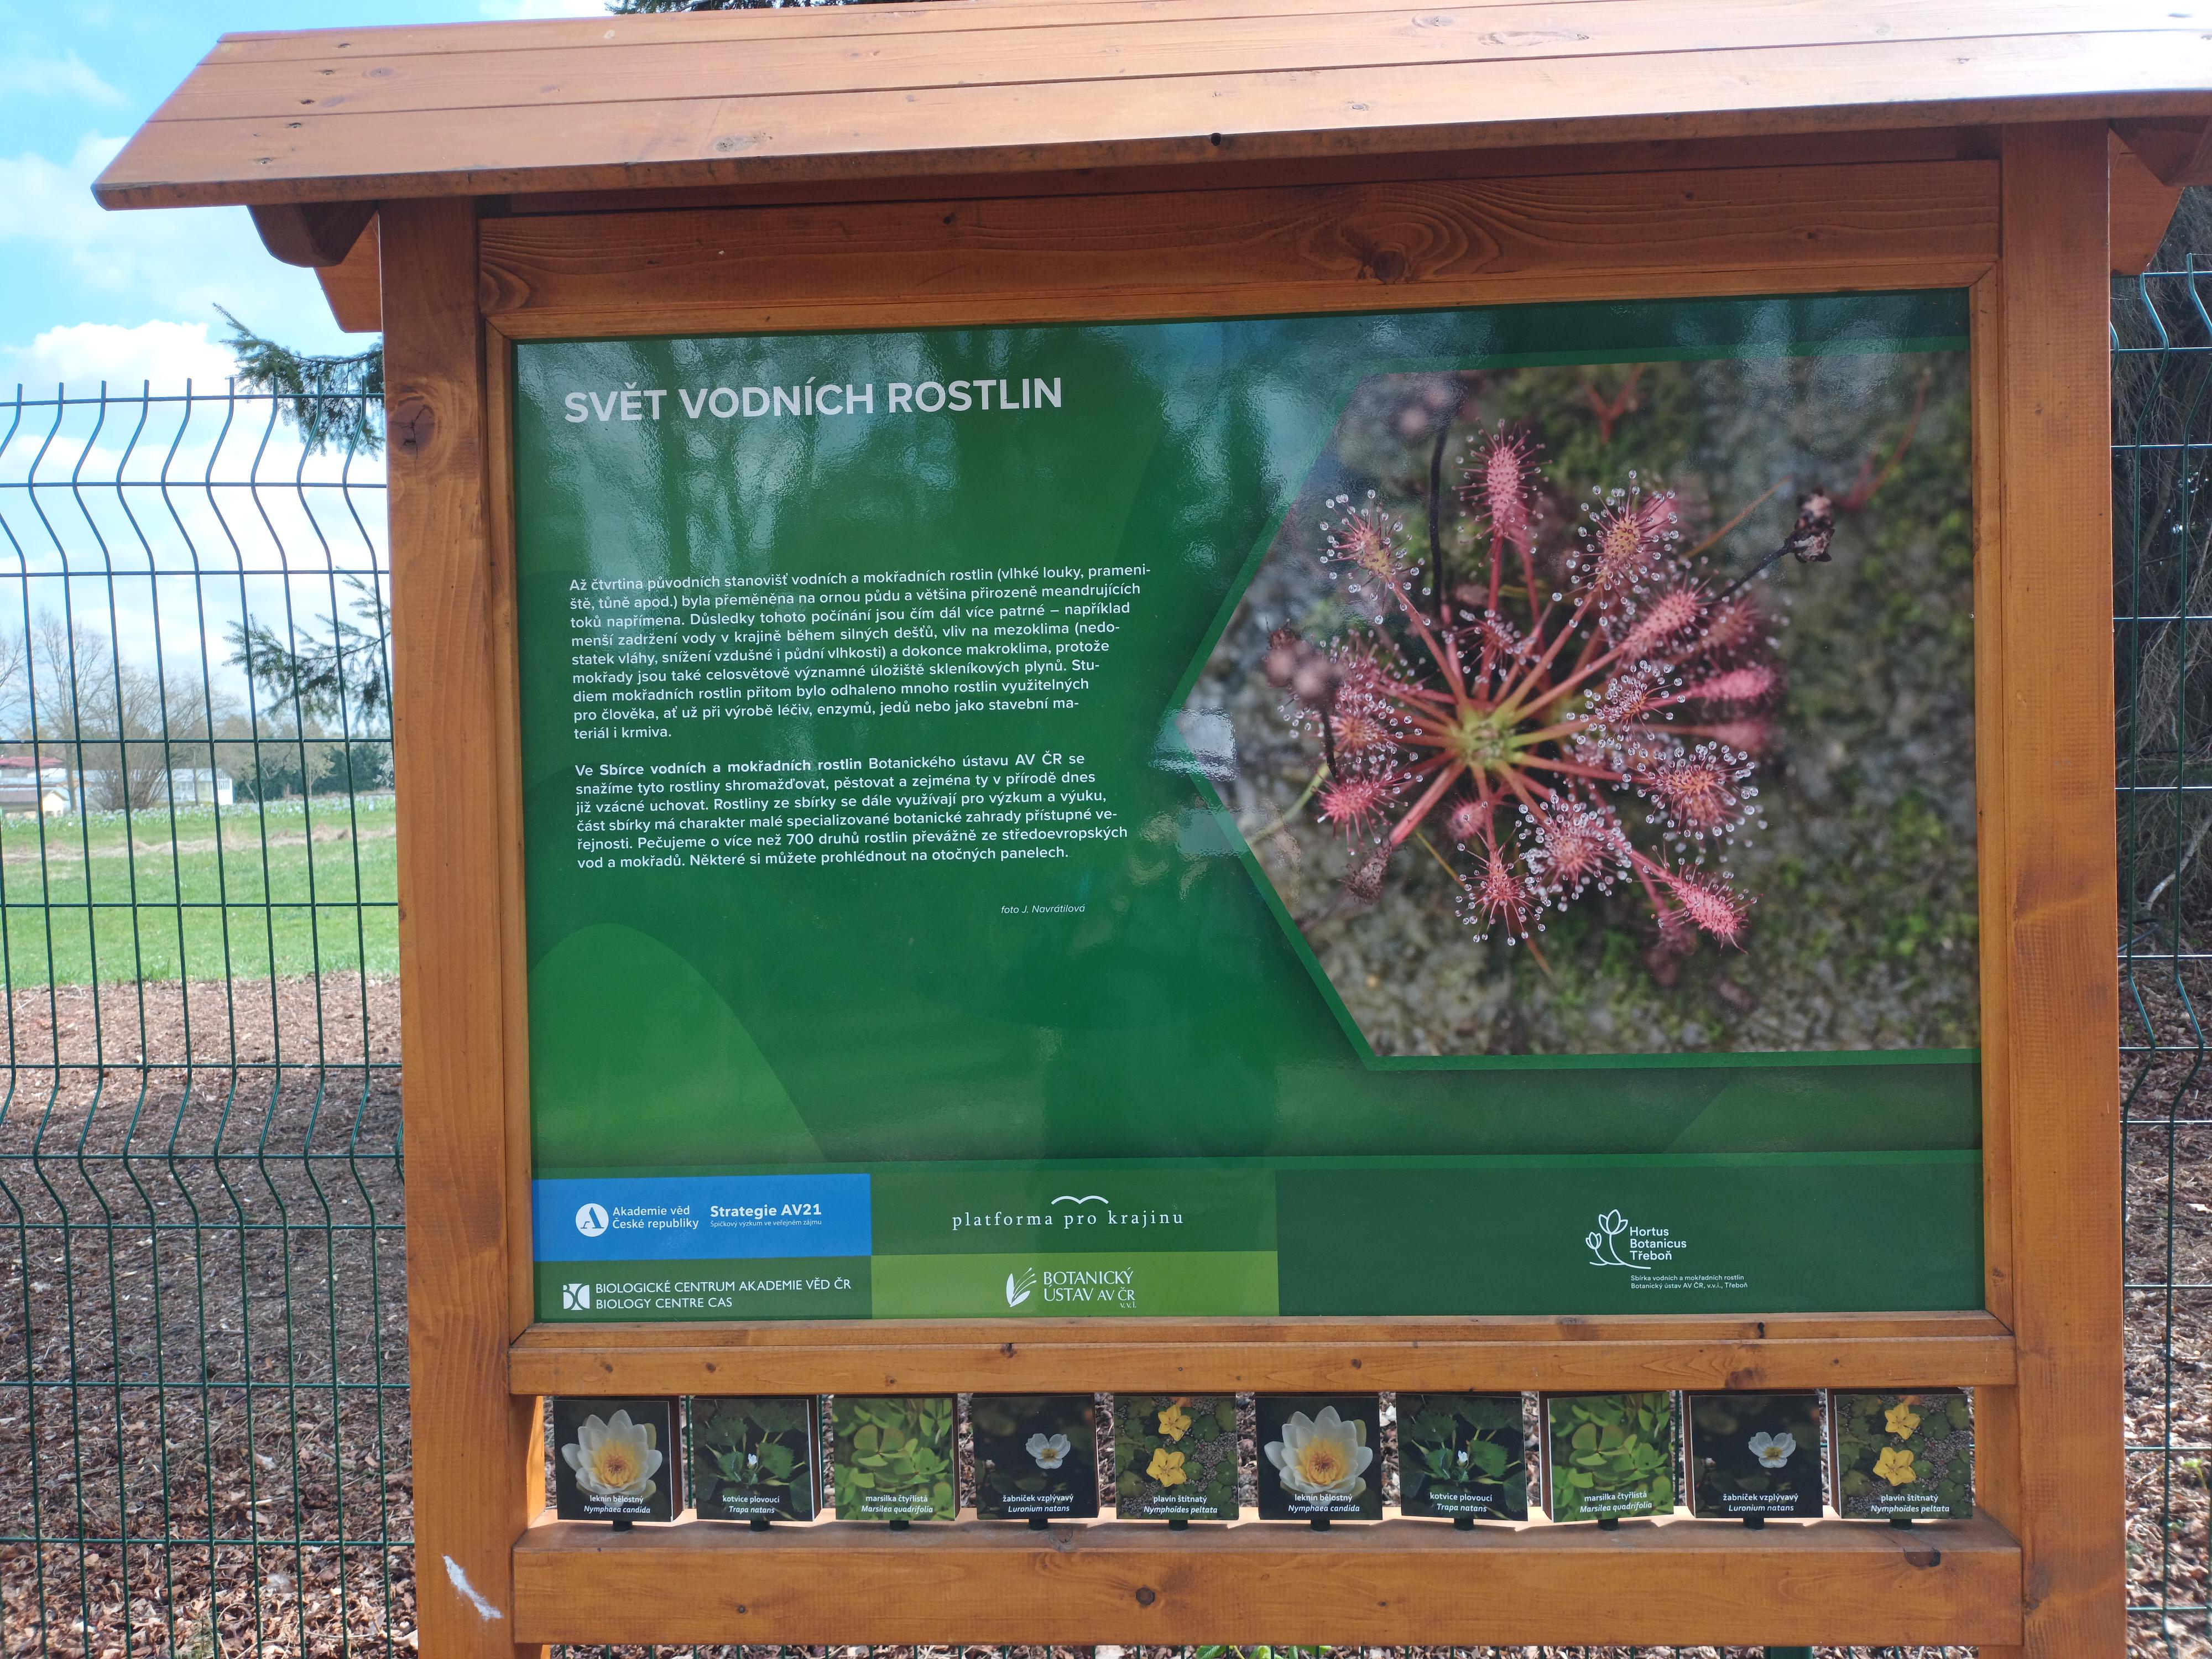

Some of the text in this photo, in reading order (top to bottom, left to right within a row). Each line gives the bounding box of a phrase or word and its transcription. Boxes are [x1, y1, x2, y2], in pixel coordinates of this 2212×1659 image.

[565, 377, 1061, 422] SVĚT VODNÍCH ROSTLIN
[570, 563, 1150, 591] Až čtvrtina původních stanovišť vodních a mokřadních rostlin (vlhké louky, prameni-
[570, 582, 1140, 611] ště, tůně apod.) byla přeměněna na ornou půdu a většina přirozeně meandrujících
[573, 659, 1099, 685] mokřady jsou také celosvětově významné úložiště skleníkových plynů. Stu-
[575, 750, 1084, 776] Ve Sbírce vodních a mokřadních rostlin Botanického ústavu AV ČR se
[576, 771, 1095, 796] snažíme tyto rostliny shromažďovat, pěstovat a zejména ty v přírodě dnes
[577, 846, 1068, 868] vod a mokřadů. Některé si můžete prohlédnout na otočných panelech.
[1032, 904, 1084, 912] Navrátilová
[613, 1205, 690, 1215] Akademie věd
[710, 1203, 821, 1219] Strategie AV21
[612, 1217, 698, 1230] České republiky
[952, 1210, 1183, 1230] platforma pro krajinu
[1630, 1227, 1668, 1236] Hortus
[1630, 1238, 1686, 1248] Botanicus
[1630, 1250, 1672, 1260] Třeboň
[1044, 1267, 1133, 1285] BOTANICKÝ
[596, 1276, 851, 1293] BIOLOGICKÉ CENTRUM AKADEMIE VĚD ČR
[1044, 1284, 1135, 1301] ÚSTAV AV ČR
[596, 1297, 732, 1308] BIOLOGY CENTRE CAS
[613, 1495, 644, 1504] bělostný
[750, 1495, 779, 1504] plovoucí
[898, 1494, 927, 1504] čtyřlistá
[1037, 1494, 1073, 1503] vzplývavý
[1154, 1495, 1207, 1504] plavín štítnatý
[1319, 1494, 1352, 1503] bělostný
[1460, 1493, 1492, 1502] plovoucí
[1584, 1490, 1646, 1501] marsilka čtyřlistá
[1759, 1493, 1798, 1503] vzplývavý
[1881, 1494, 1938, 1503] plavín štítnatý
[584, 1504, 621, 1514] Nymphaea
[729, 1506, 748, 1514] Trapa
[894, 1505, 933, 1514] quadrifolia
[1144, 1505, 1217, 1515] Nymphoides peltata
[1288, 1504, 1328, 1513] Nymphaea
[1437, 1503, 1458, 1512] Trapa
[1580, 1501, 1652, 1512] Marsilea quadrifolia
[1871, 1505, 1949, 1514] Nymphoides peltata
